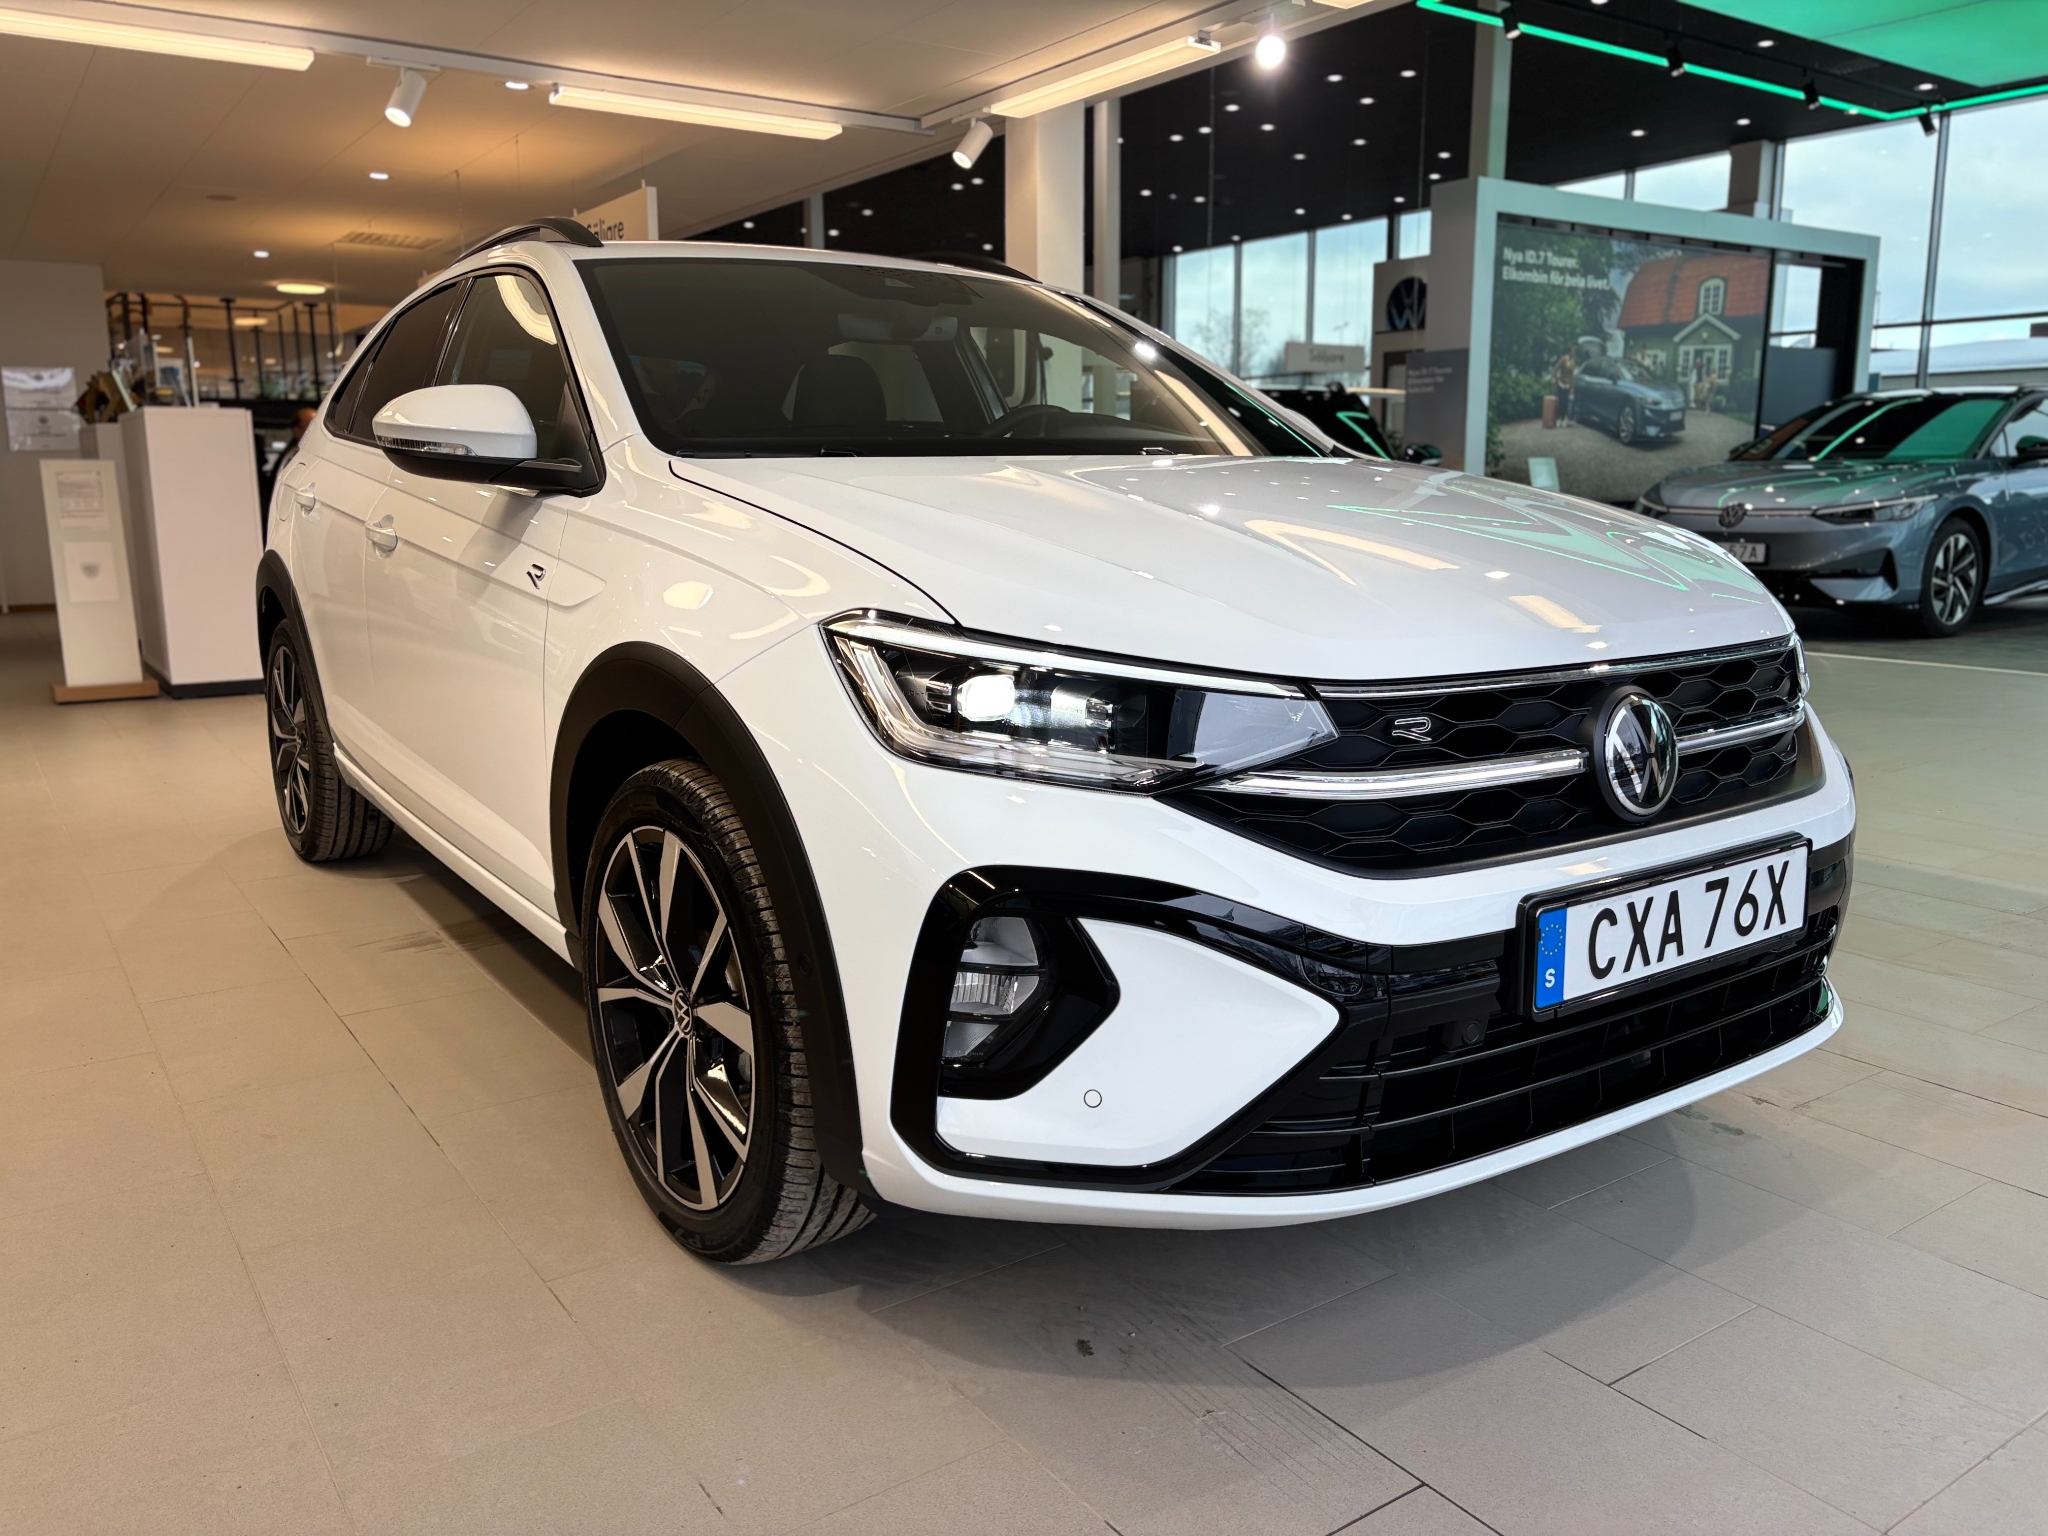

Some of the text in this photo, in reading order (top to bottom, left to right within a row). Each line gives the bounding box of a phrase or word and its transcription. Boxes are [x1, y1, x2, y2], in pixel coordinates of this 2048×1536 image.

[586, 217, 625, 241] äljare
[1502, 246, 1523, 266] Nya
[1524, 248, 1545, 266] ID.7
[1391, 716, 1433, 742] R
[1588, 860, 1790, 980] CXA 76X
[1544, 967, 1556, 989] S
